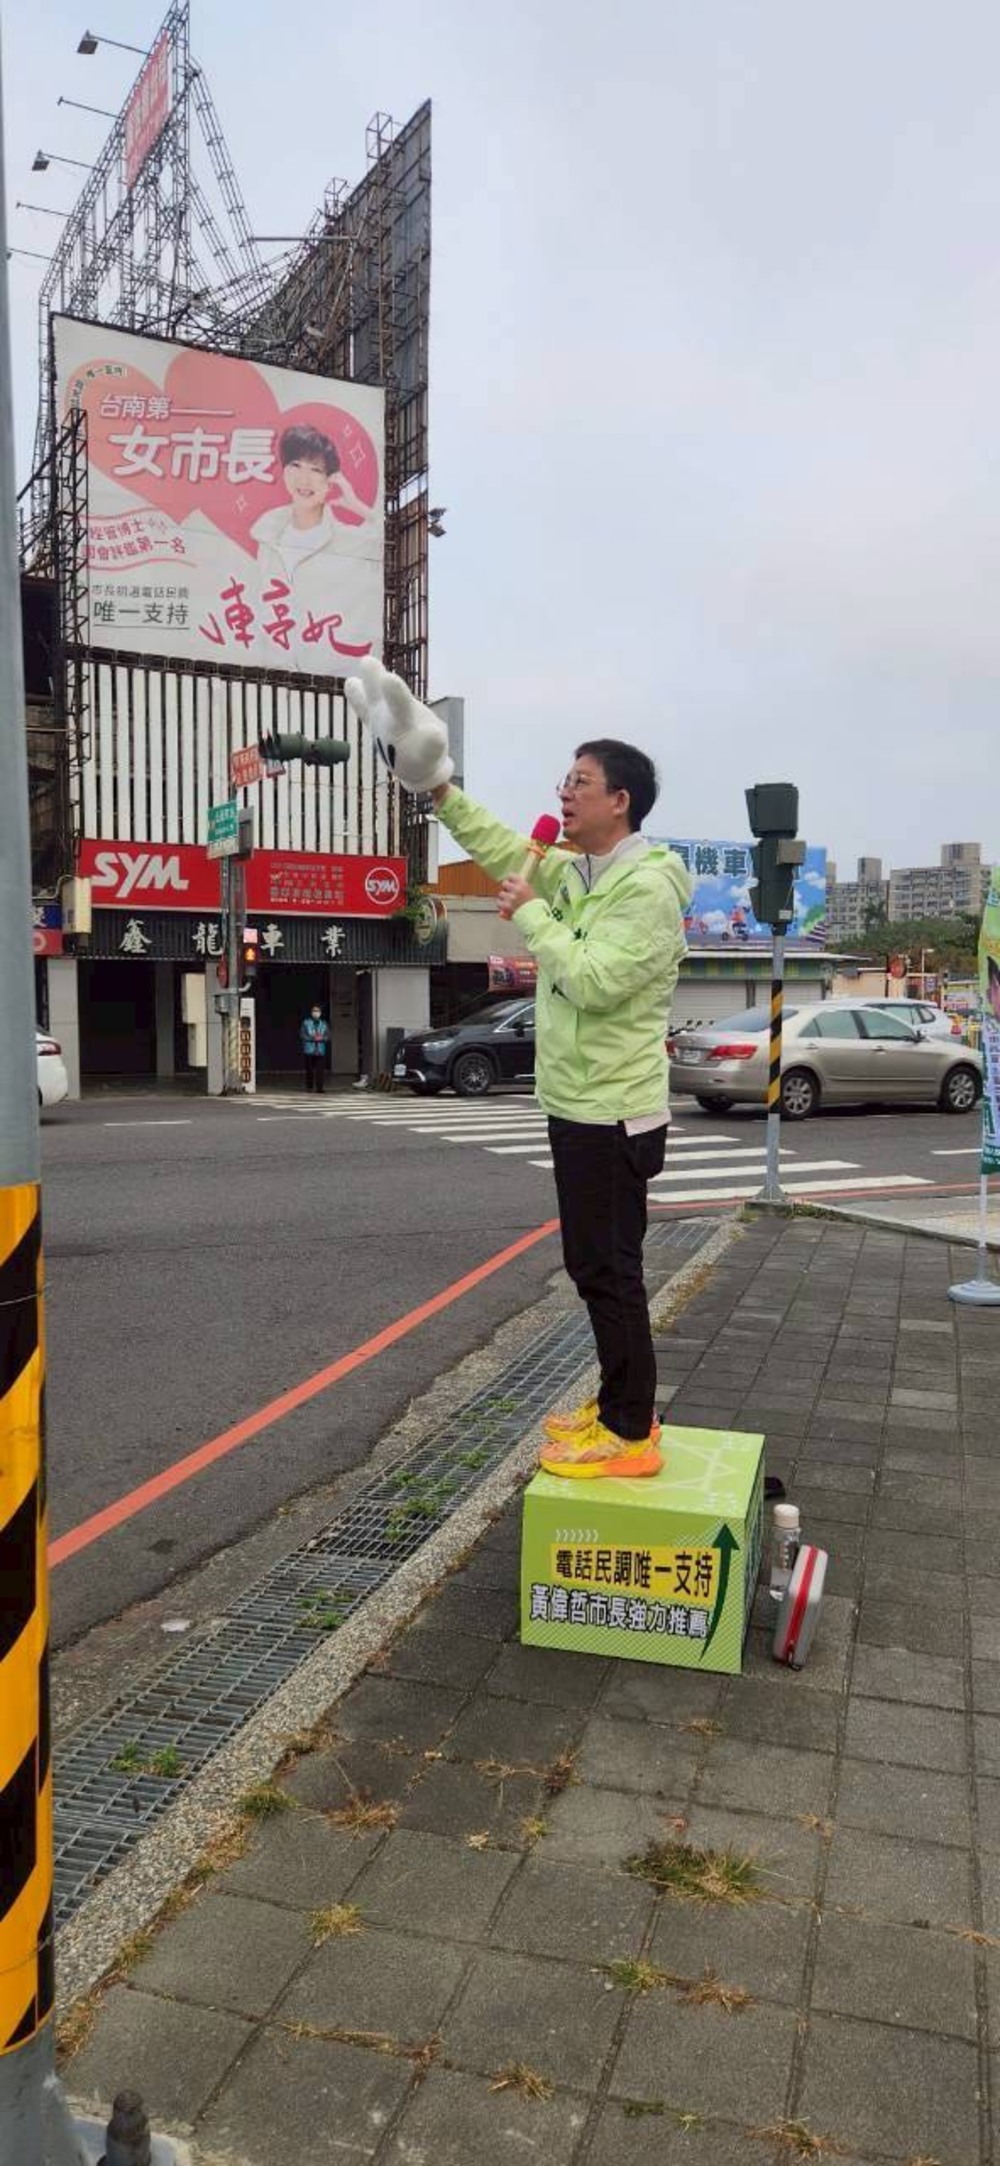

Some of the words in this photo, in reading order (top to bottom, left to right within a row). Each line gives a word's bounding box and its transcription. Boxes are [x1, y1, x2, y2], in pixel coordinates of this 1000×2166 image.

[109, 425, 276, 484] 女市長
[93, 600, 189, 625] 唯一支持
[91, 851, 190, 898] SYM
[366, 879, 397, 896] SYM
[119, 918, 347, 957] 鑫龍車業
[555, 1549, 714, 1598] 電話民調唯一支持
[530, 1583, 711, 1640] 黃偉哲市長強力推薦
